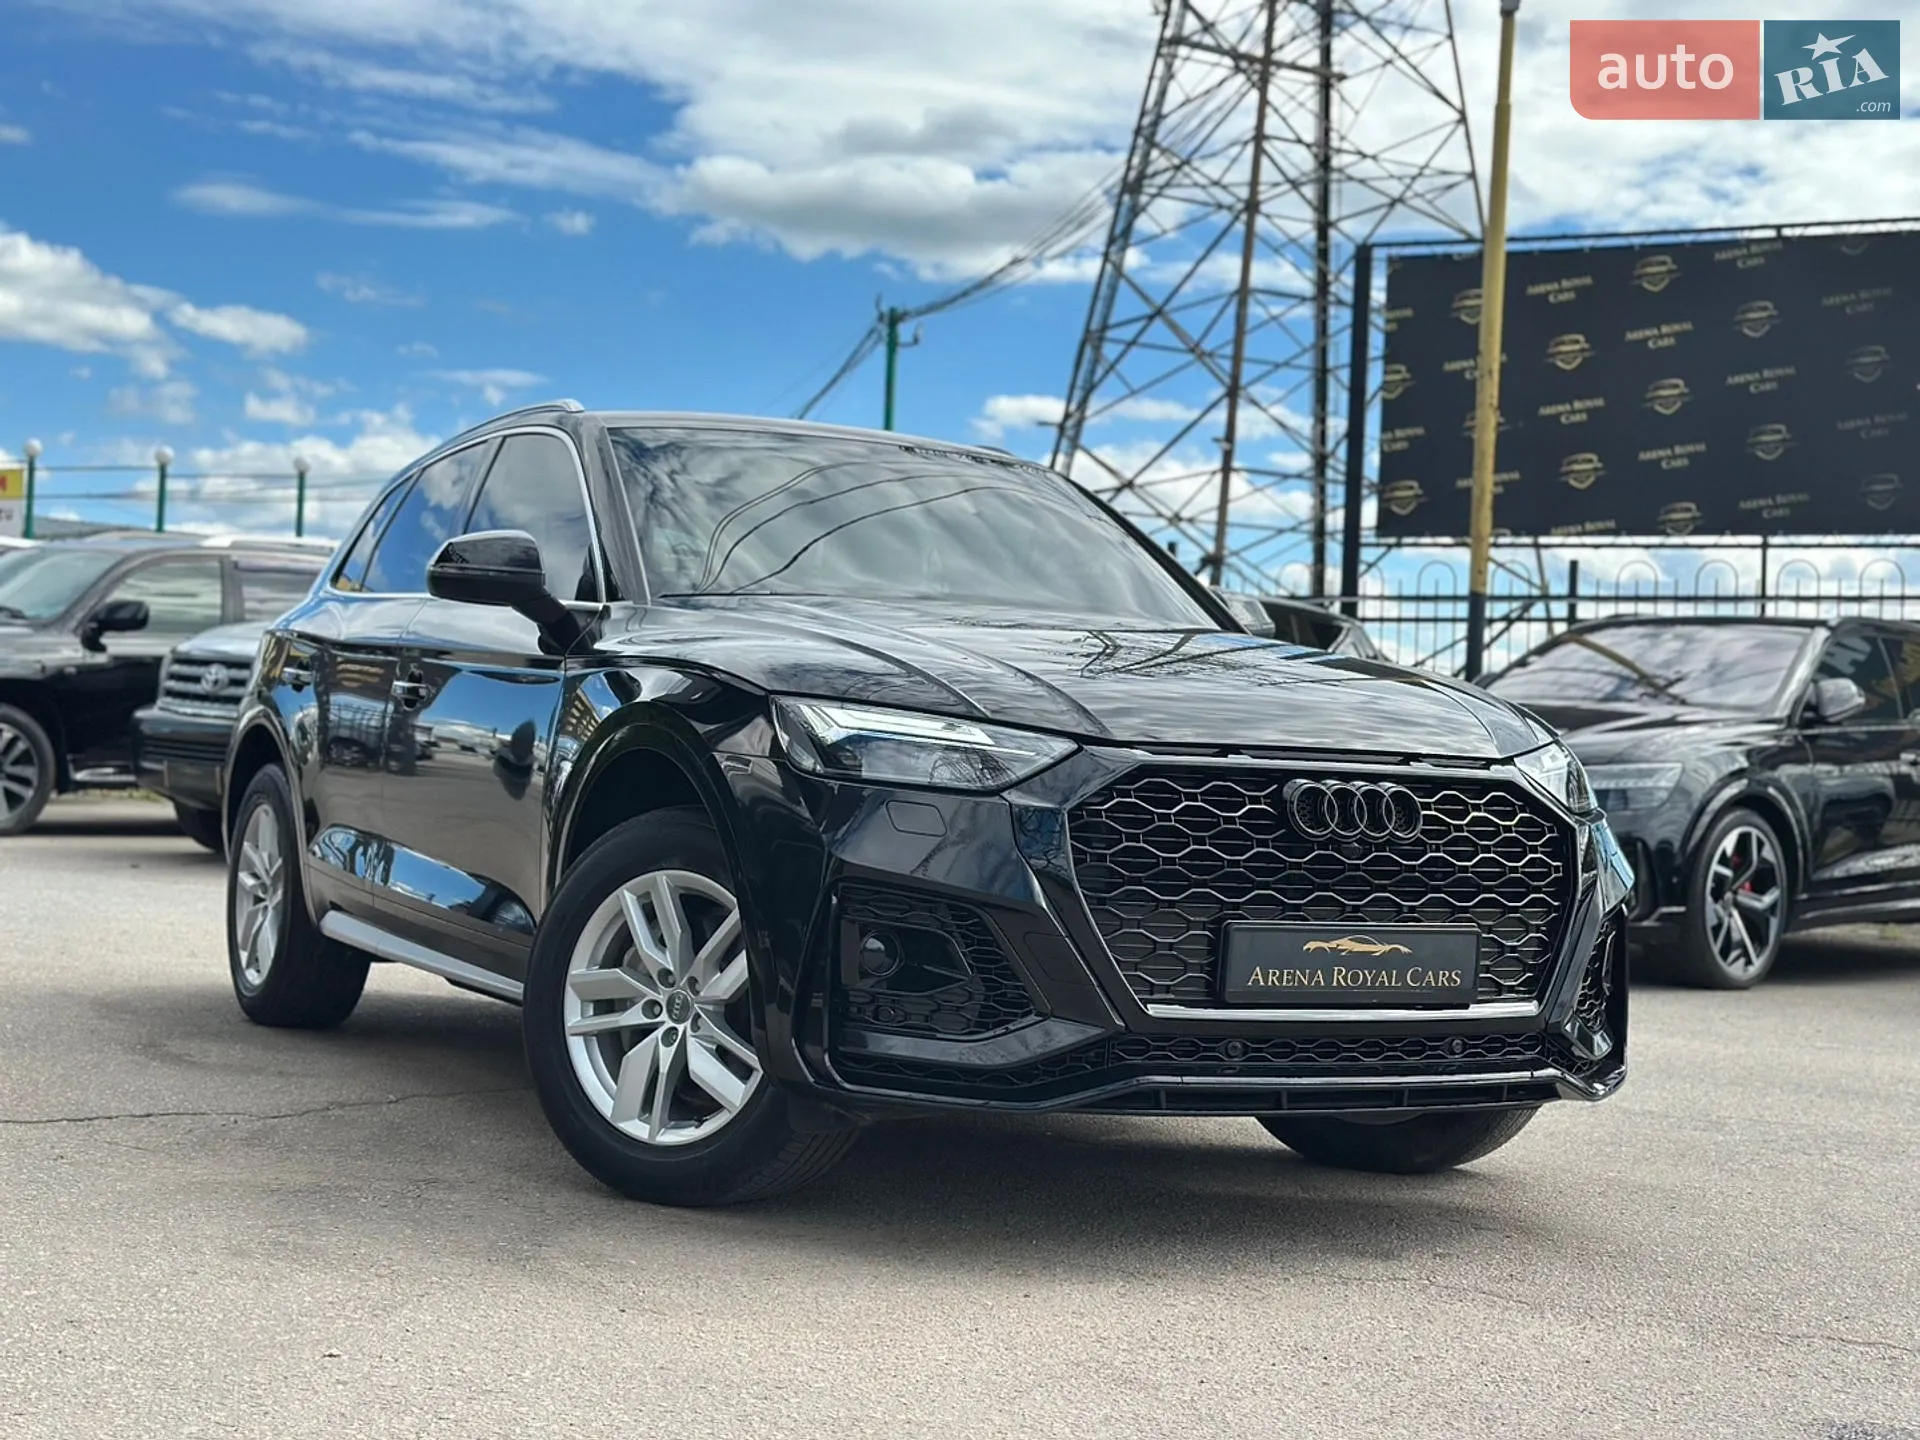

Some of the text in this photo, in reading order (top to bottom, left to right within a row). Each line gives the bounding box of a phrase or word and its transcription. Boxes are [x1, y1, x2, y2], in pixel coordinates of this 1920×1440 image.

[1247, 966, 1462, 988] ARENA ROYAL CARS
